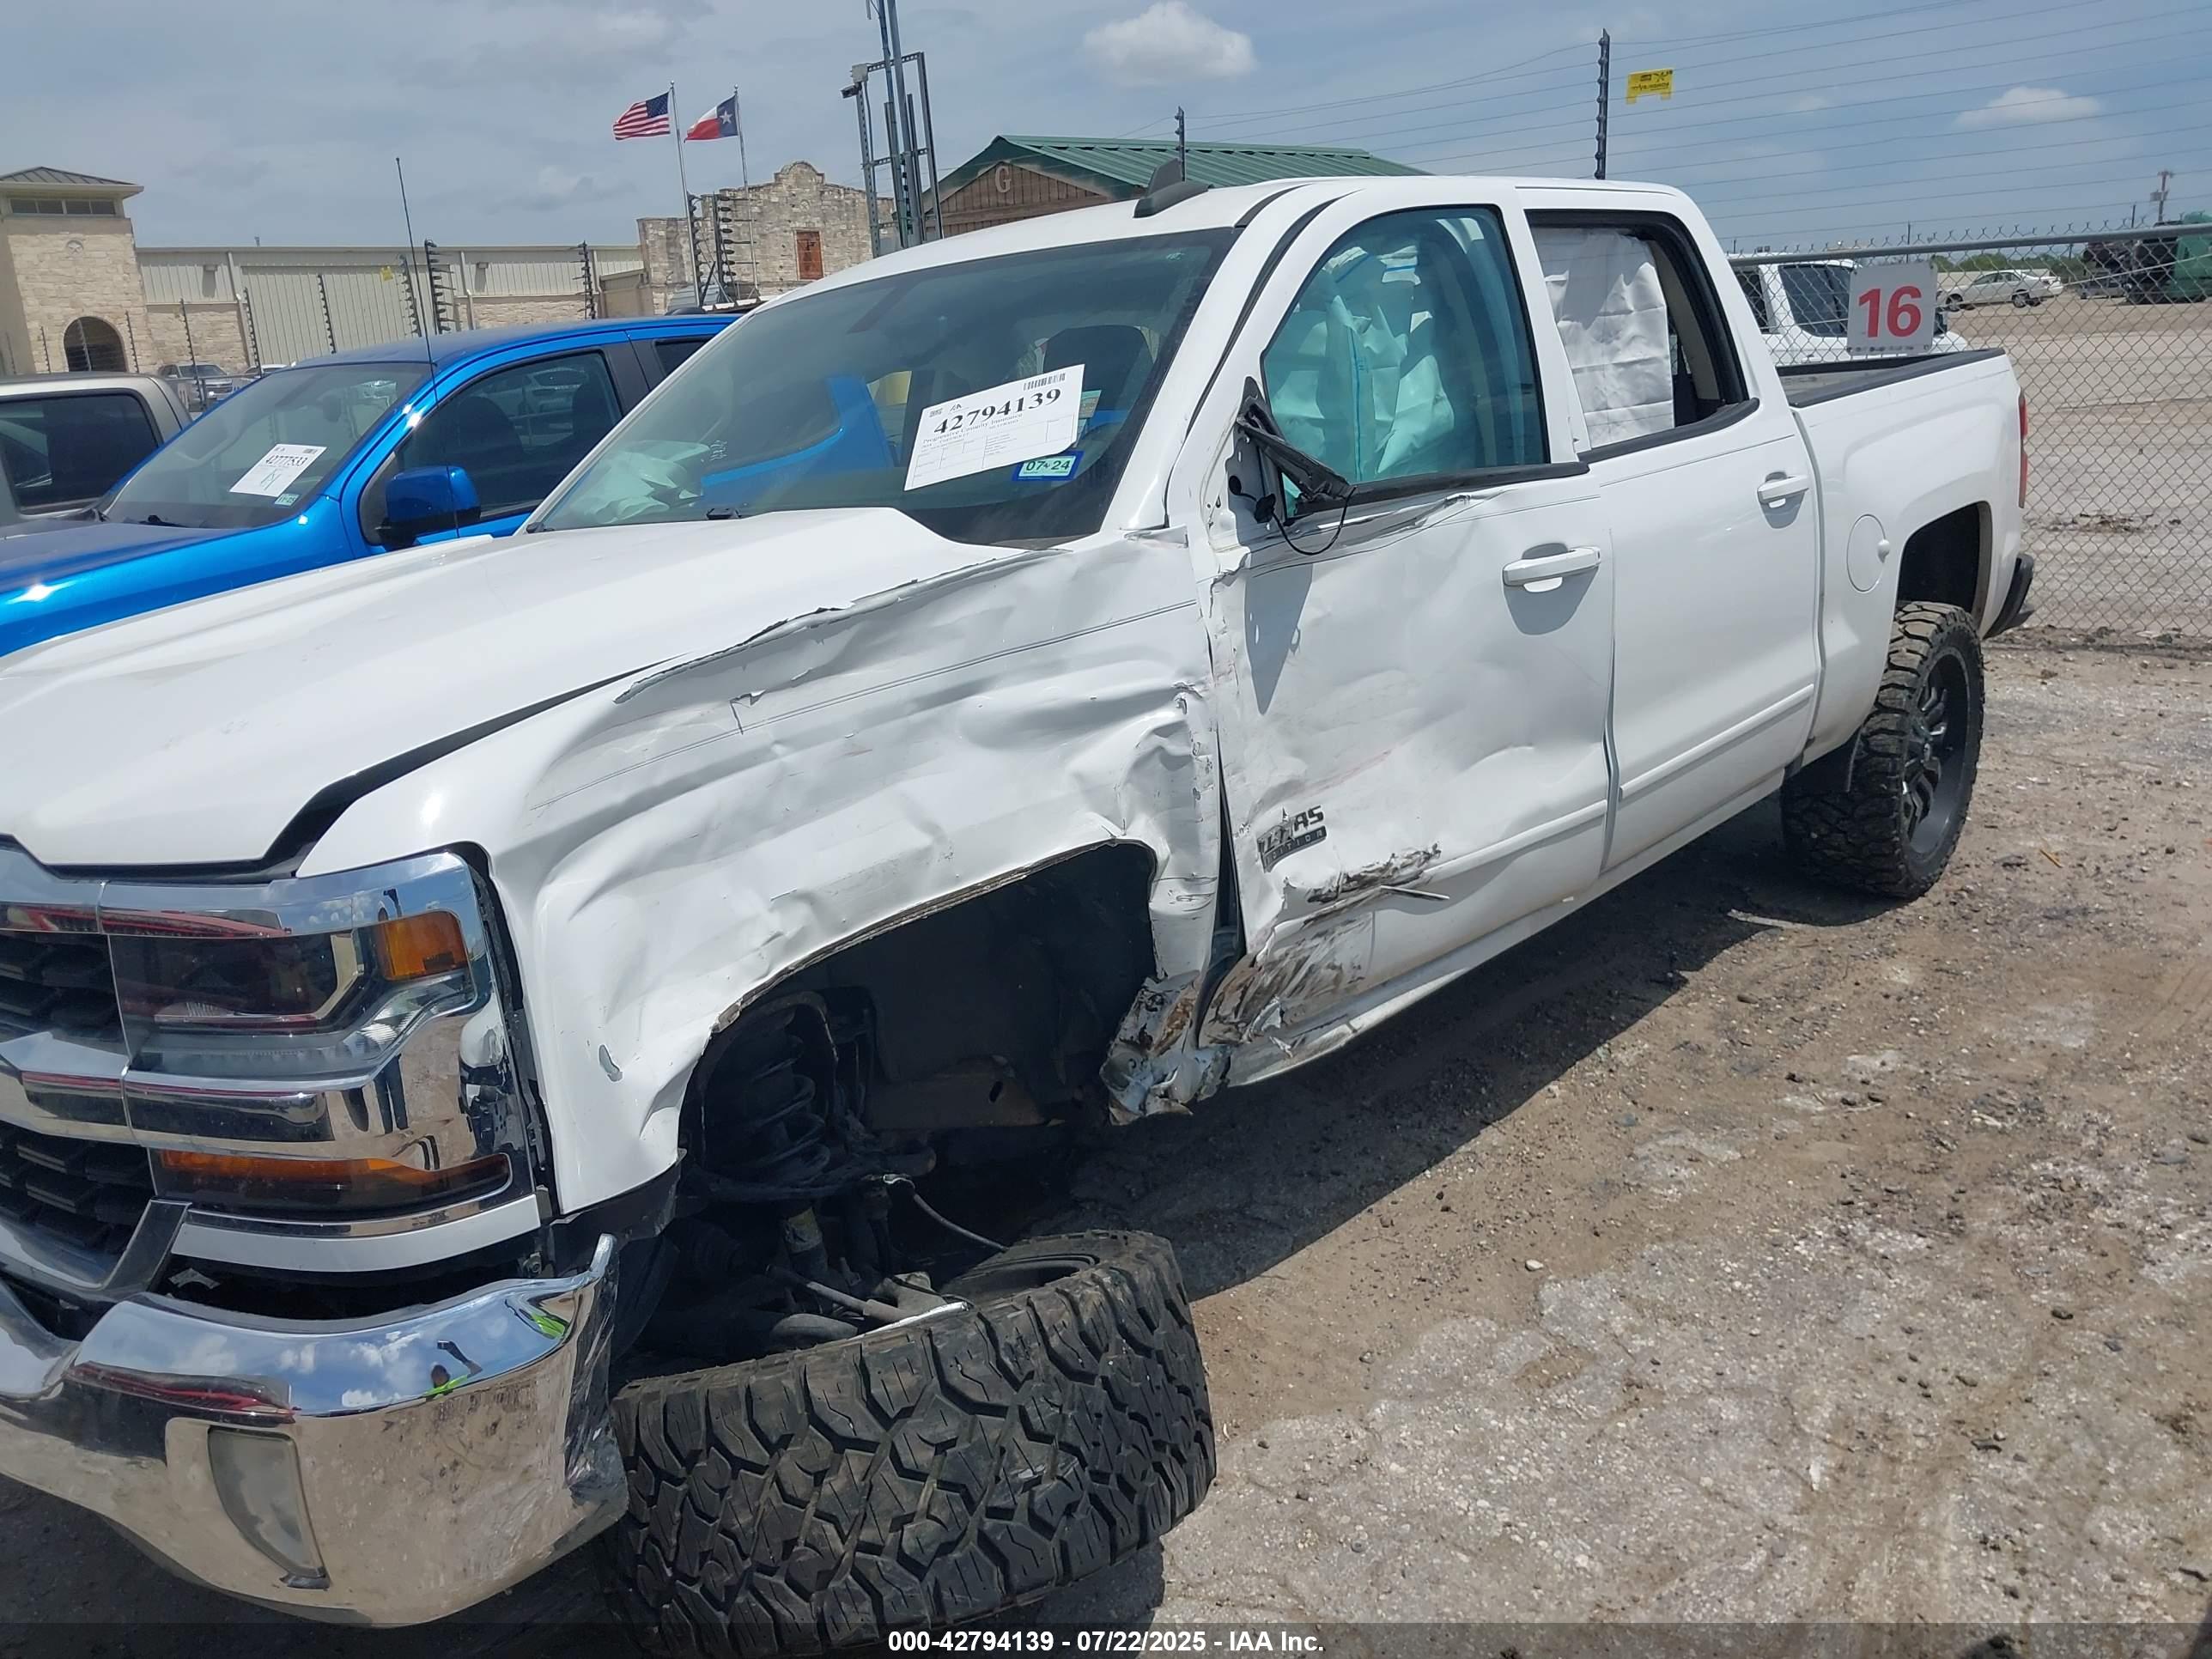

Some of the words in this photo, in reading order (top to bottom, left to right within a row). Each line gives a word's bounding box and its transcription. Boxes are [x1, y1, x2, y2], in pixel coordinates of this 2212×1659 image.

[995, 166, 1012, 192] G
[1858, 285, 1923, 338] 16
[933, 388, 1061, 434] 42794139
[1025, 460, 1046, 471] 07
[1050, 460, 1071, 471] 24
